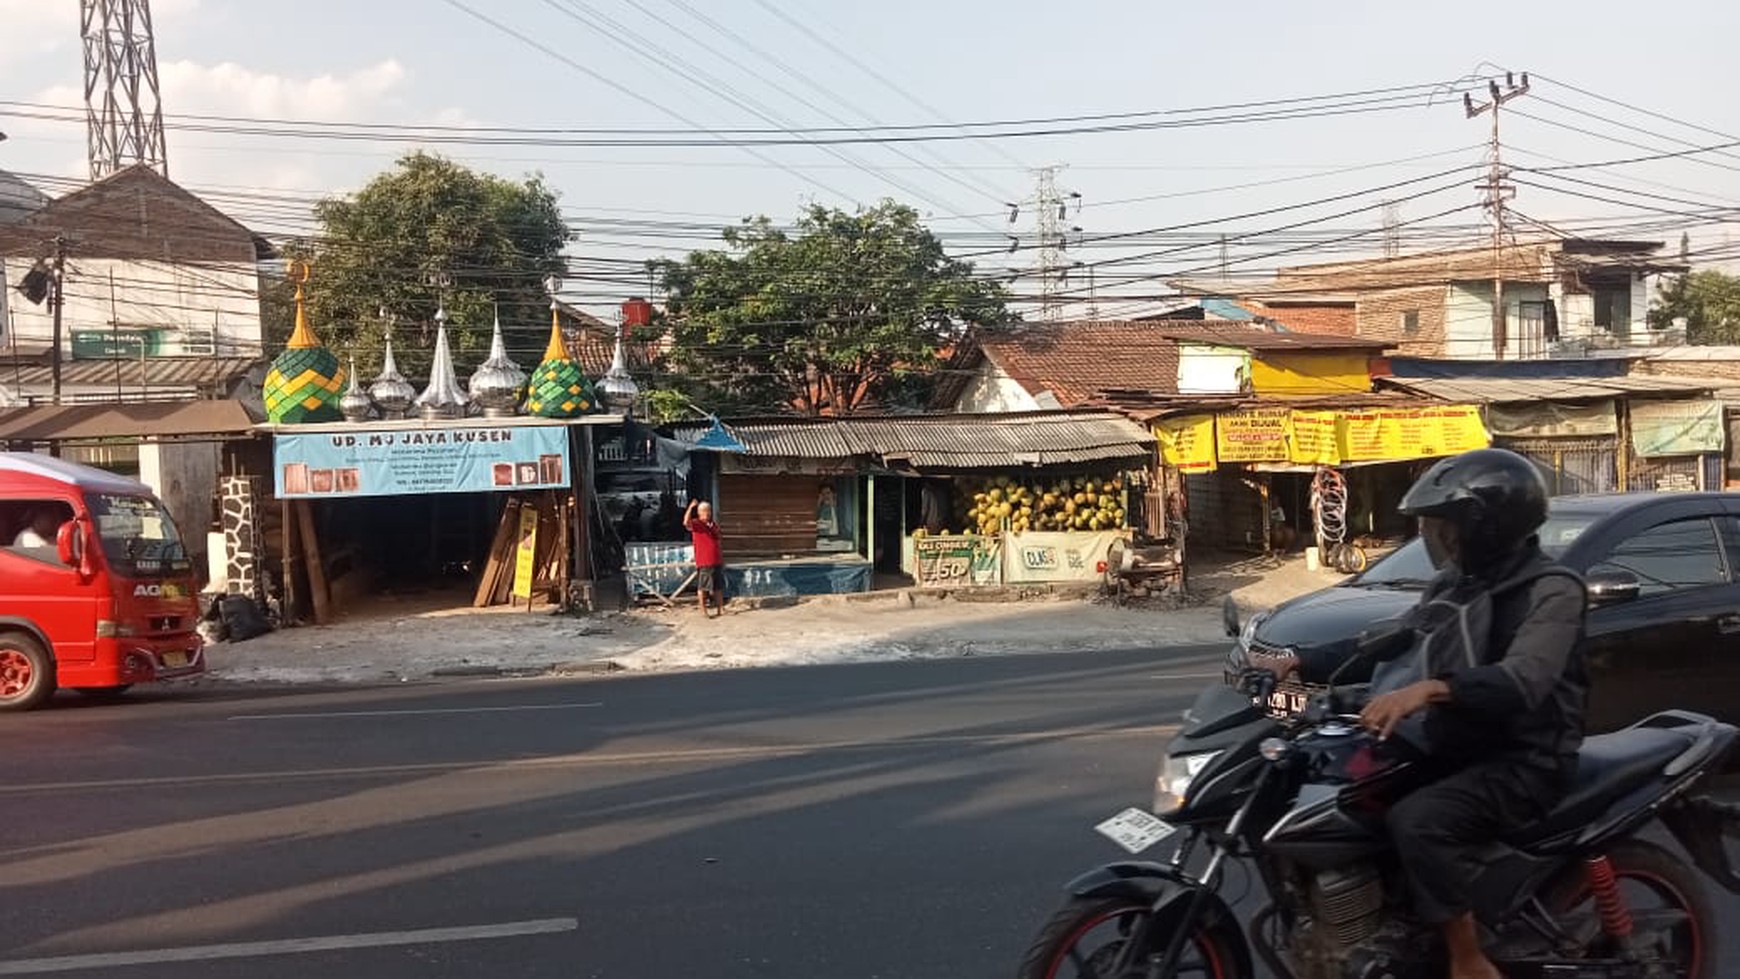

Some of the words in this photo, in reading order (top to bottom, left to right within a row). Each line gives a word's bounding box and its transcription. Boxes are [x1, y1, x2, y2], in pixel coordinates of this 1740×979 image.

[332, 436, 362, 447] UD.
[369, 434, 394, 446] MJ
[402, 432, 447, 445] JAYA
[453, 430, 512, 443] KUSEN
